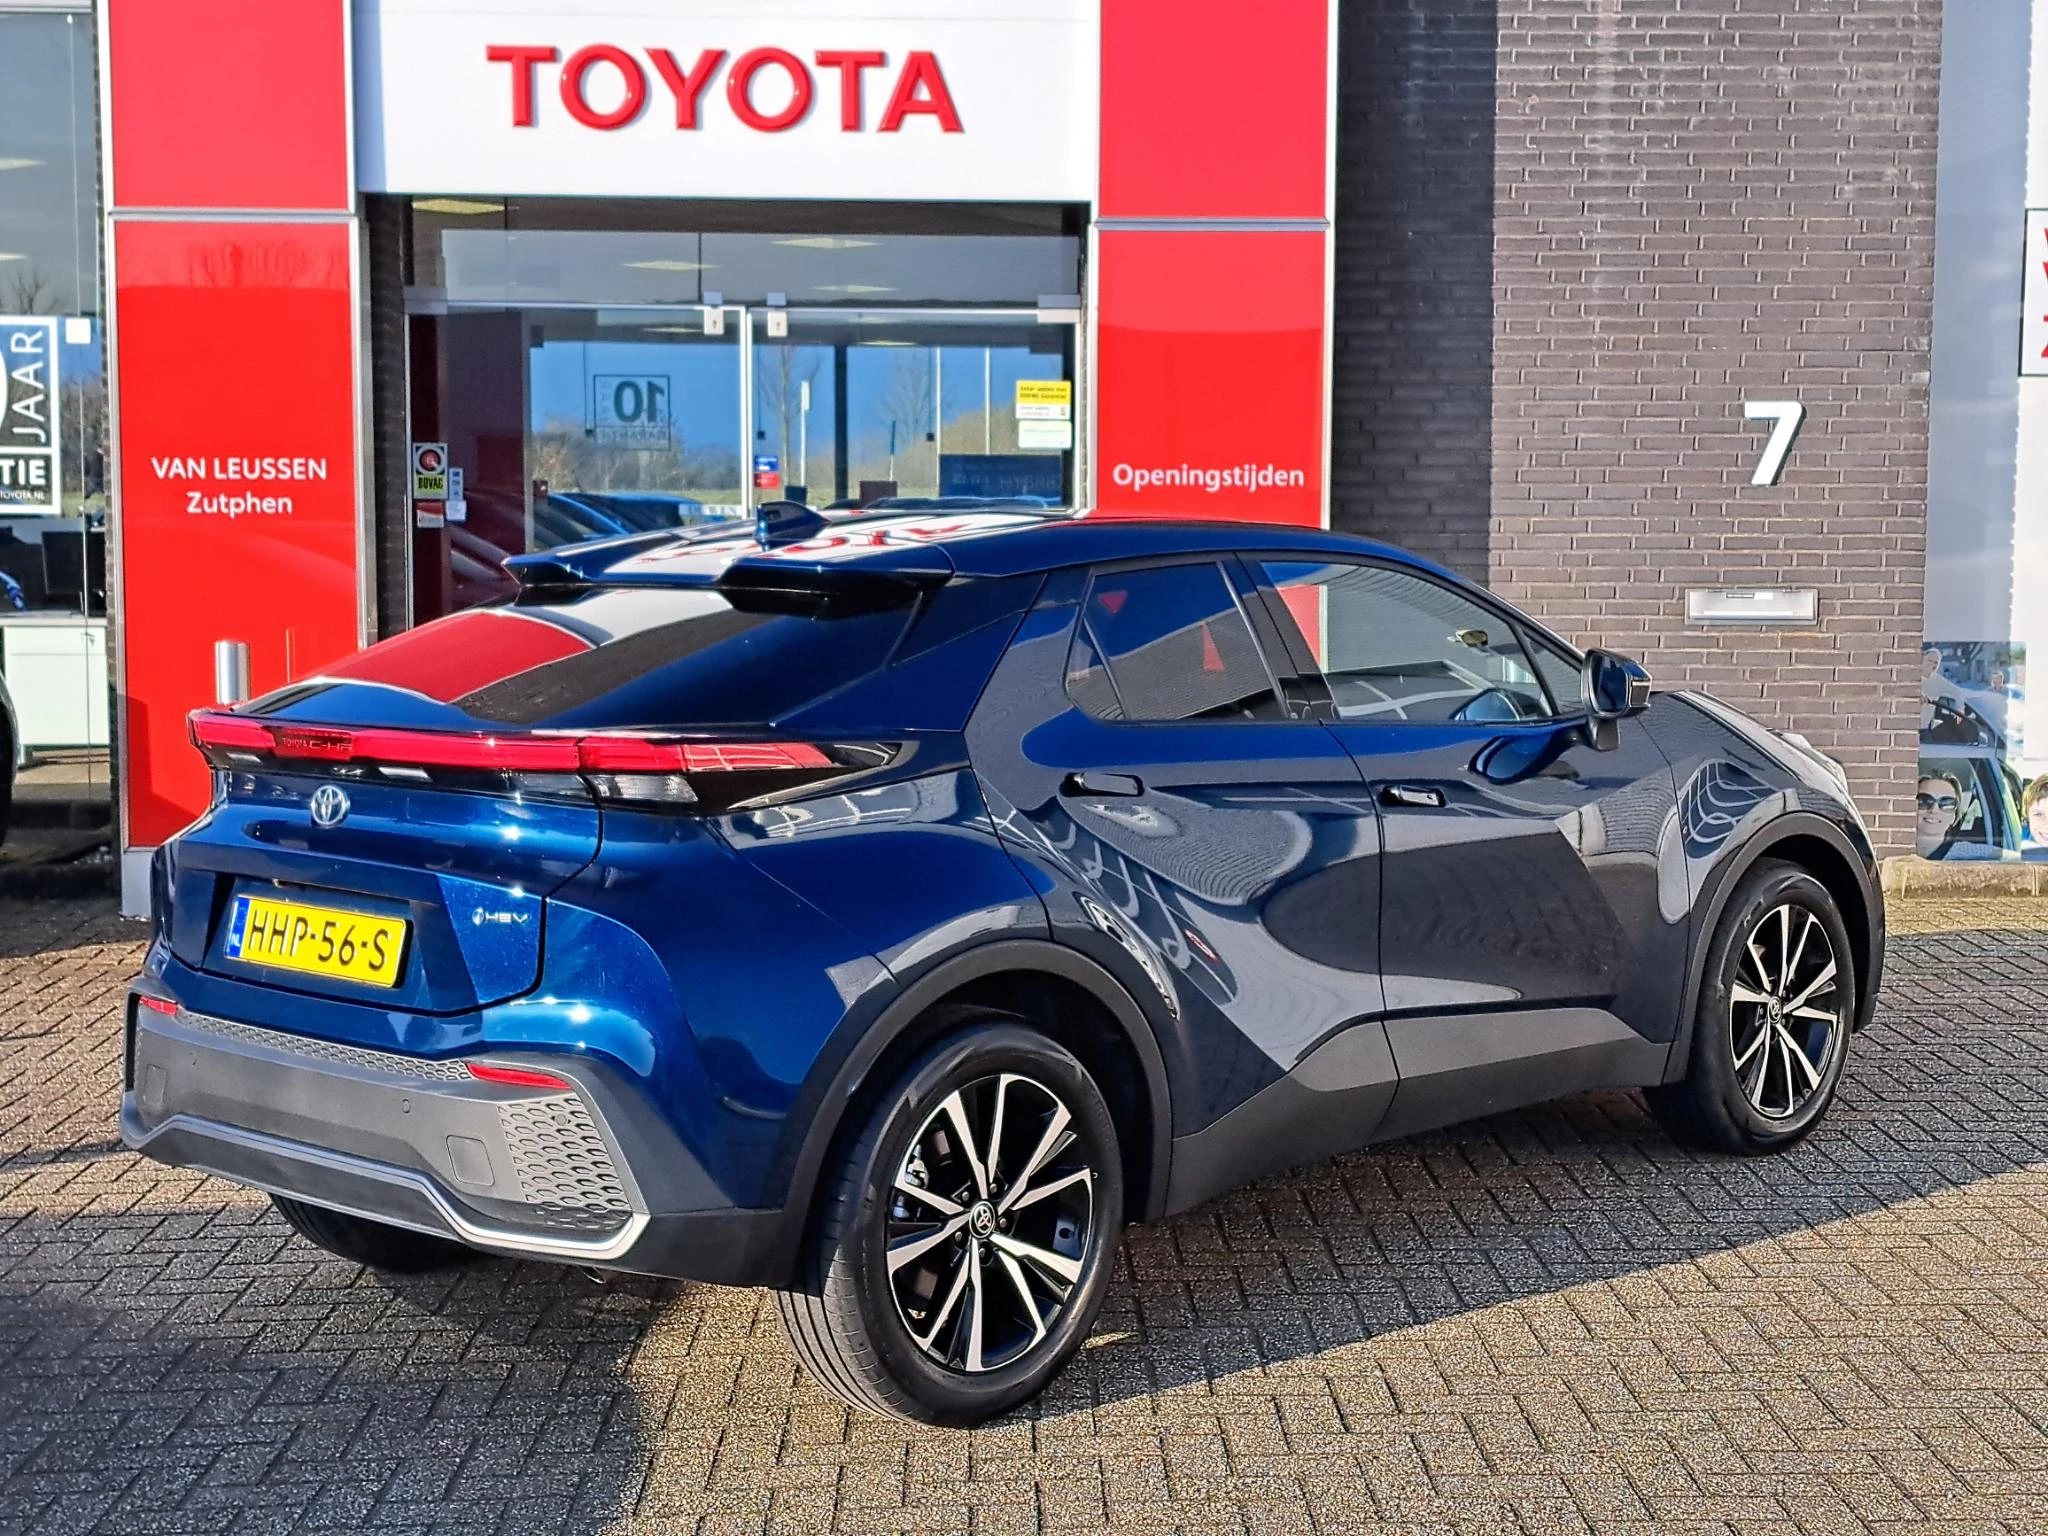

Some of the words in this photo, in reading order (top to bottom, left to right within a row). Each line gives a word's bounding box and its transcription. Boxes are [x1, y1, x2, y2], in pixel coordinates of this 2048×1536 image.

[486, 44, 966, 134] TOYOTA
[10, 330, 47, 443] JAAR
[1744, 401, 1807, 486] 7
[151, 456, 206, 480] VAN
[213, 457, 328, 481] LEUSSEN
[1112, 463, 1305, 493] Openingstijden
[186, 490, 293, 519] Zutphen
[282, 736, 308, 748] TOYOTA
[309, 740, 353, 752] C-HR
[485, 911, 529, 923] HEV
[230, 933, 241, 947] NL
[248, 909, 391, 972] HHP-56-S
